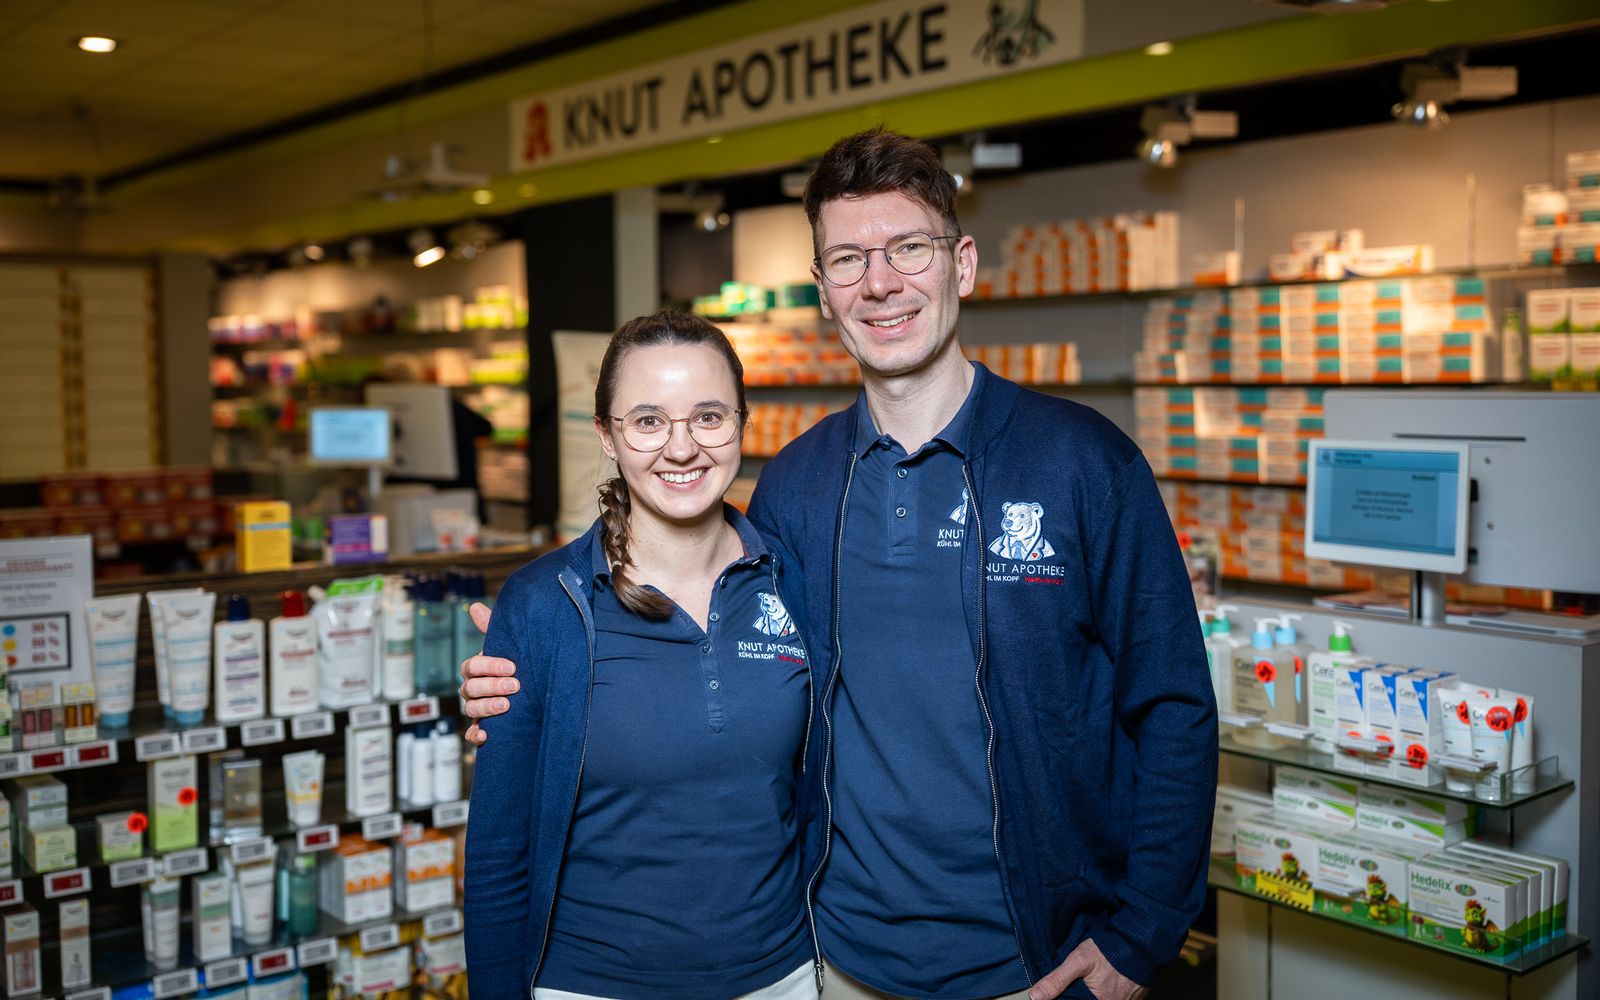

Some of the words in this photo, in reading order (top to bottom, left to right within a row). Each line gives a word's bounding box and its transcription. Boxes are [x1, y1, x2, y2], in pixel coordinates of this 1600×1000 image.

[562, 75, 665, 150] KNUT
[681, 5, 950, 126] APOTHEKE
[938, 528, 964, 539] KNUT
[985, 562, 1007, 573] NUT
[1011, 563, 1065, 577] APOTHEKE
[1002, 575, 1020, 583] KOPF
[738, 641, 763, 652] KNUT
[767, 643, 805, 659] APOTHEKE
[1311, 662, 1335, 679] Cera
[1410, 871, 1452, 892] Hedelix
